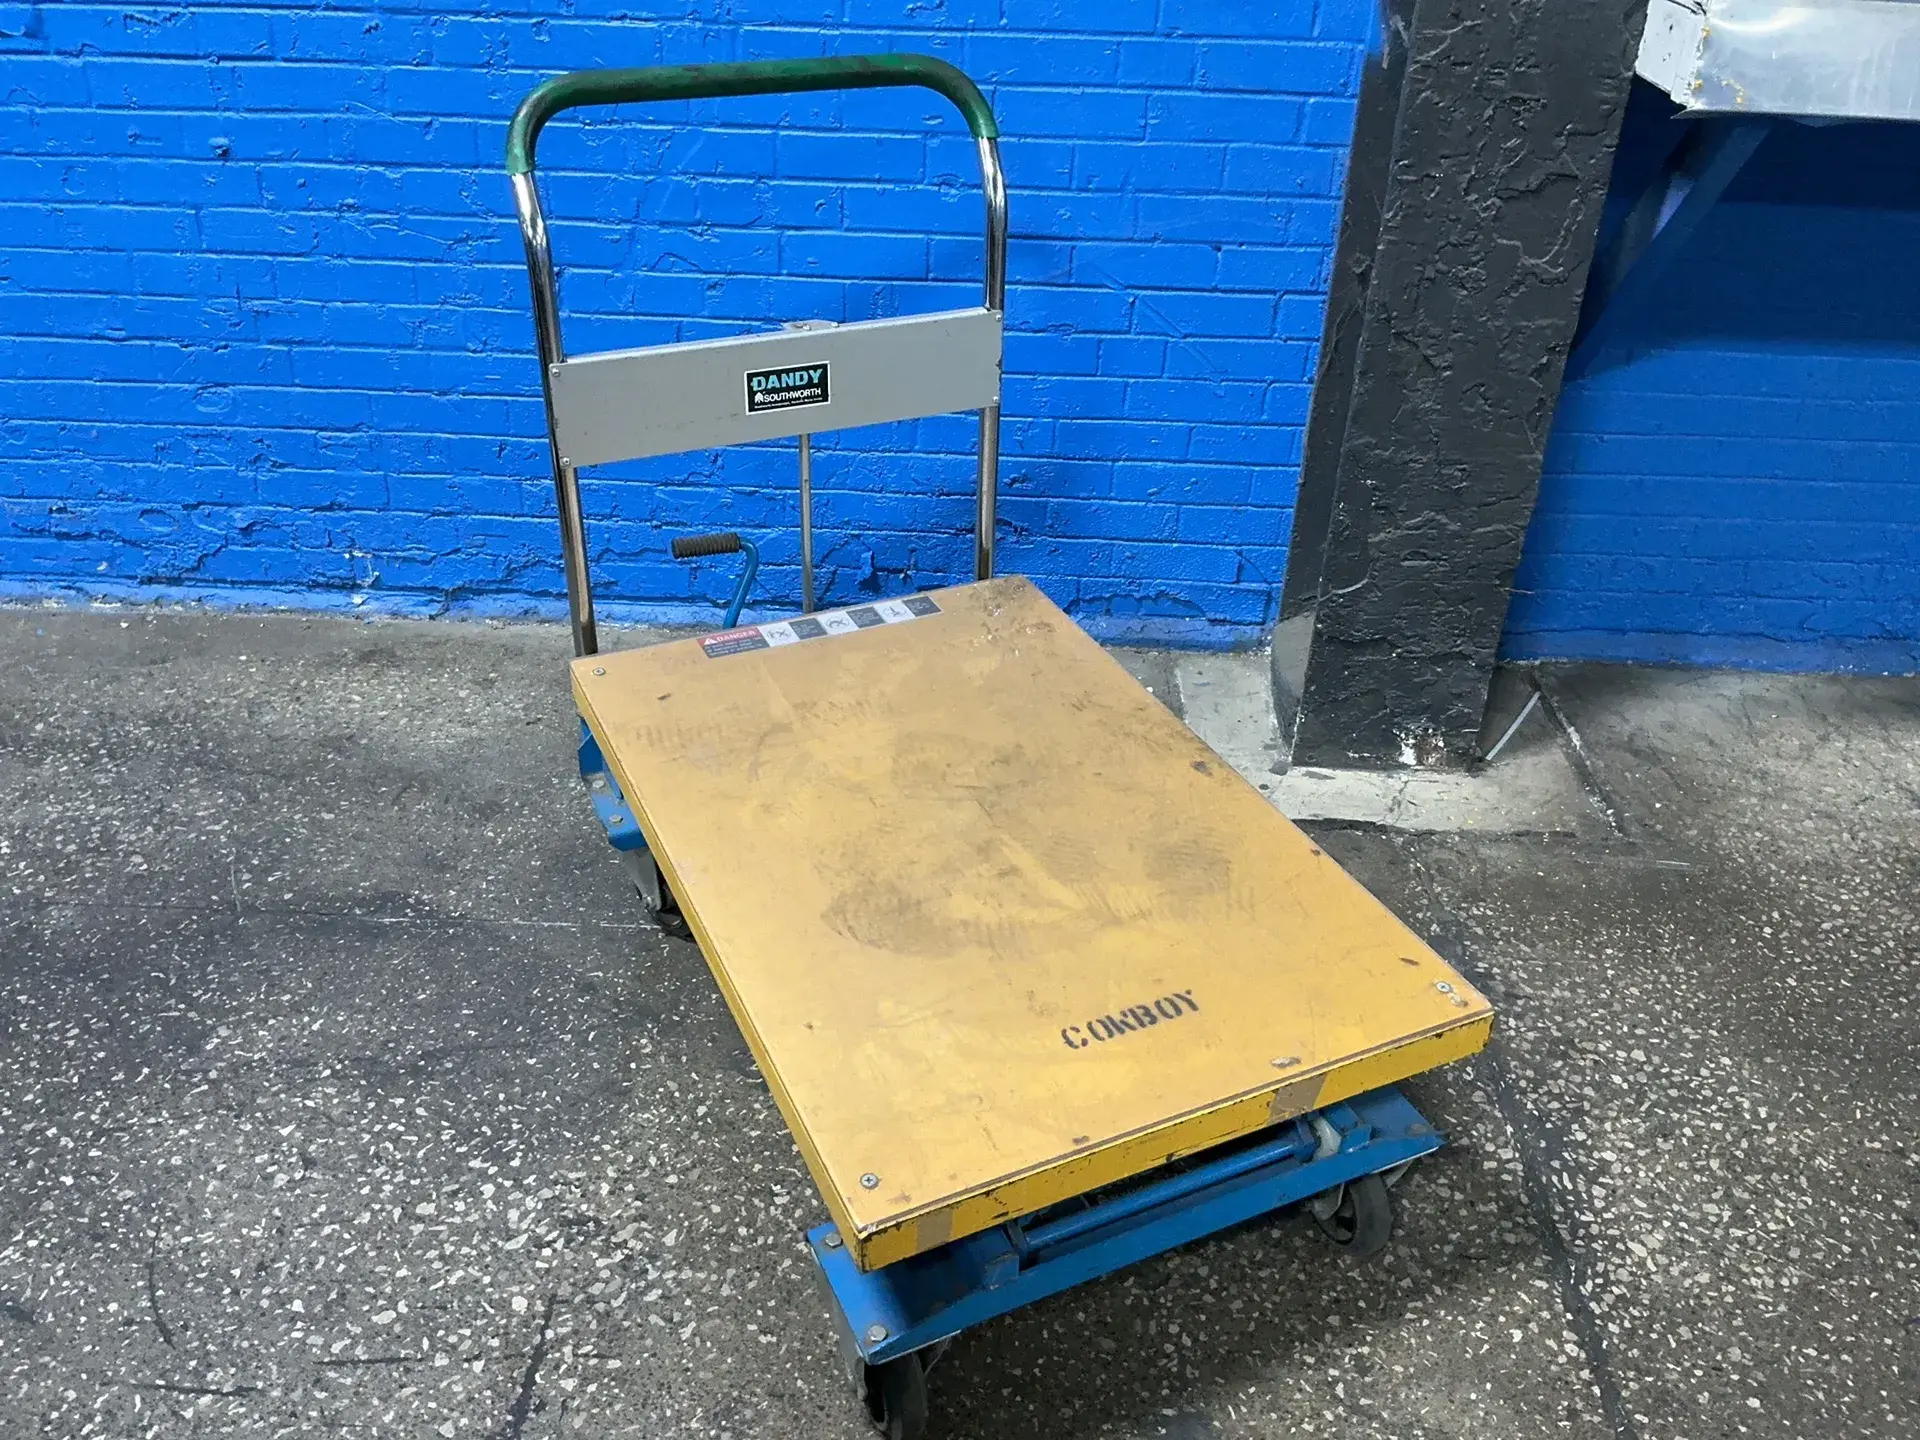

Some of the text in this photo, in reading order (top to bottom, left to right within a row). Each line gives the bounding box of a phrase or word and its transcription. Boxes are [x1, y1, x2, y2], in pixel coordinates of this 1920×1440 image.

[751, 369, 823, 391] DANDY
[763, 388, 822, 403] SOUTHWORTH
[716, 630, 757, 642] DANGER
